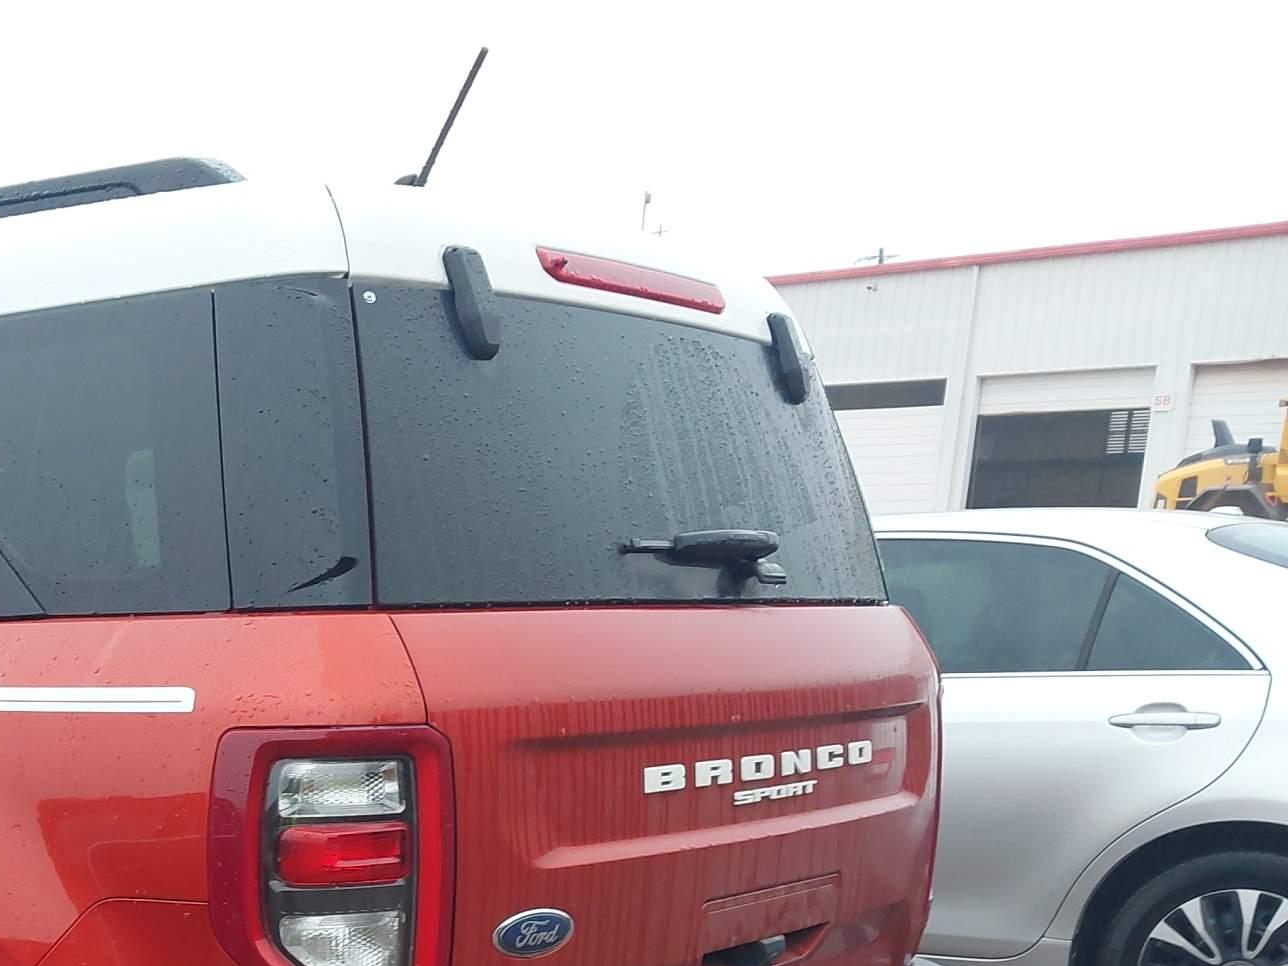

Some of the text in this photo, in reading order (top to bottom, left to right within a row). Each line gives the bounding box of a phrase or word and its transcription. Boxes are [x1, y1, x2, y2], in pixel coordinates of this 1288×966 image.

[643, 740, 873, 794] BRONCO
[733, 779, 818, 806] SPORT
[515, 920, 560, 948] Ford
